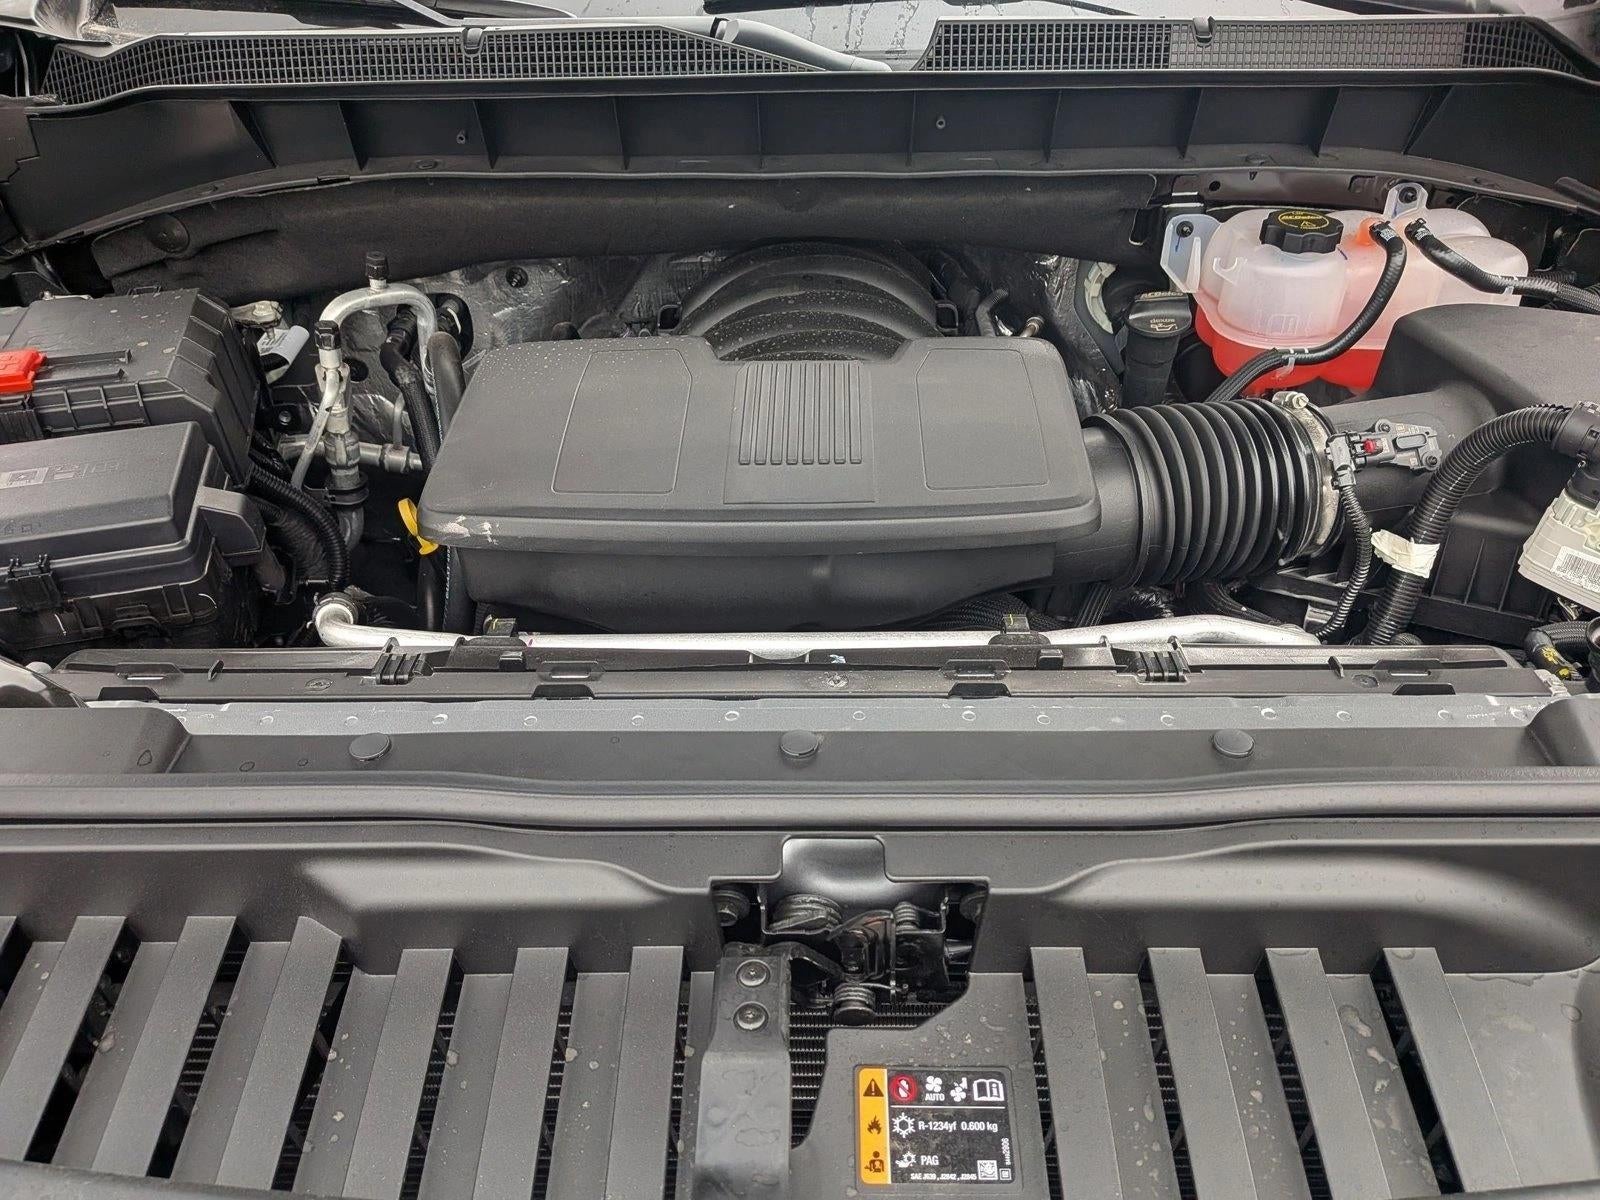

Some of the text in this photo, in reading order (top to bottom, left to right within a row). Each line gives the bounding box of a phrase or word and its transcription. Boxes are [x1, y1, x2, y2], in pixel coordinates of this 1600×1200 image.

[925, 1094, 945, 1102] AUTO
[918, 1121, 998, 1132] R-1234yf 0.600 kg
[920, 1155, 939, 1165] PAG
